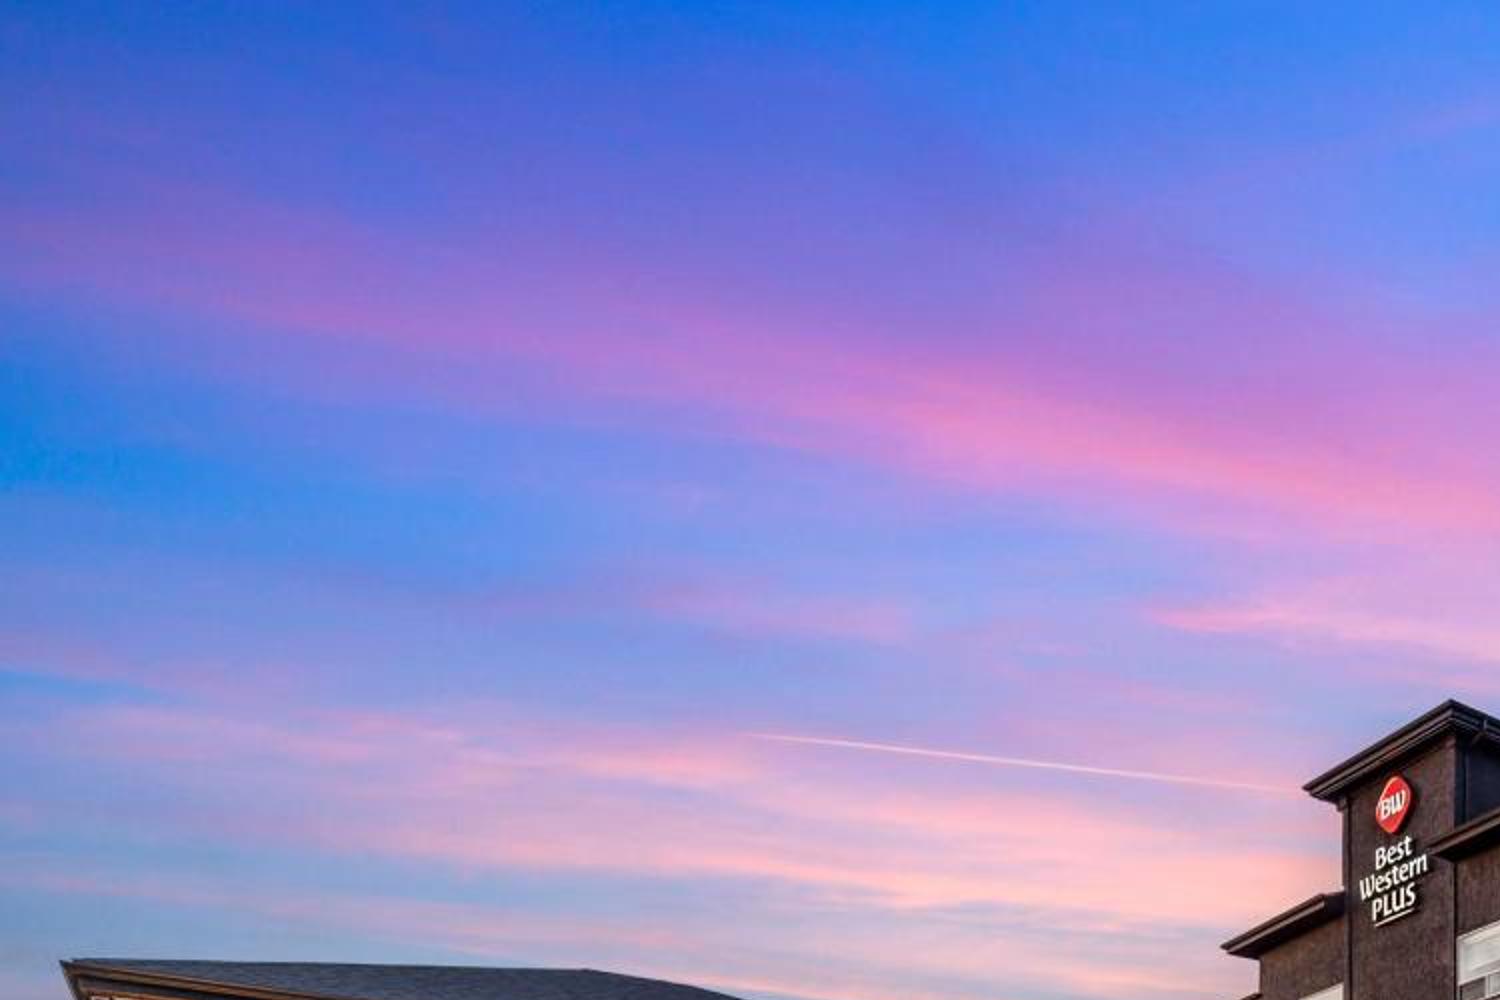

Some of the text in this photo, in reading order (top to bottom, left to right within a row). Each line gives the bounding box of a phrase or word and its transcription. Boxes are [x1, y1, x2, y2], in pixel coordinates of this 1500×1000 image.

[1381, 789, 1406, 820] BW
[1375, 835, 1413, 871] Best
[1359, 853, 1429, 901] Western
[1371, 881, 1417, 922] PLUS
